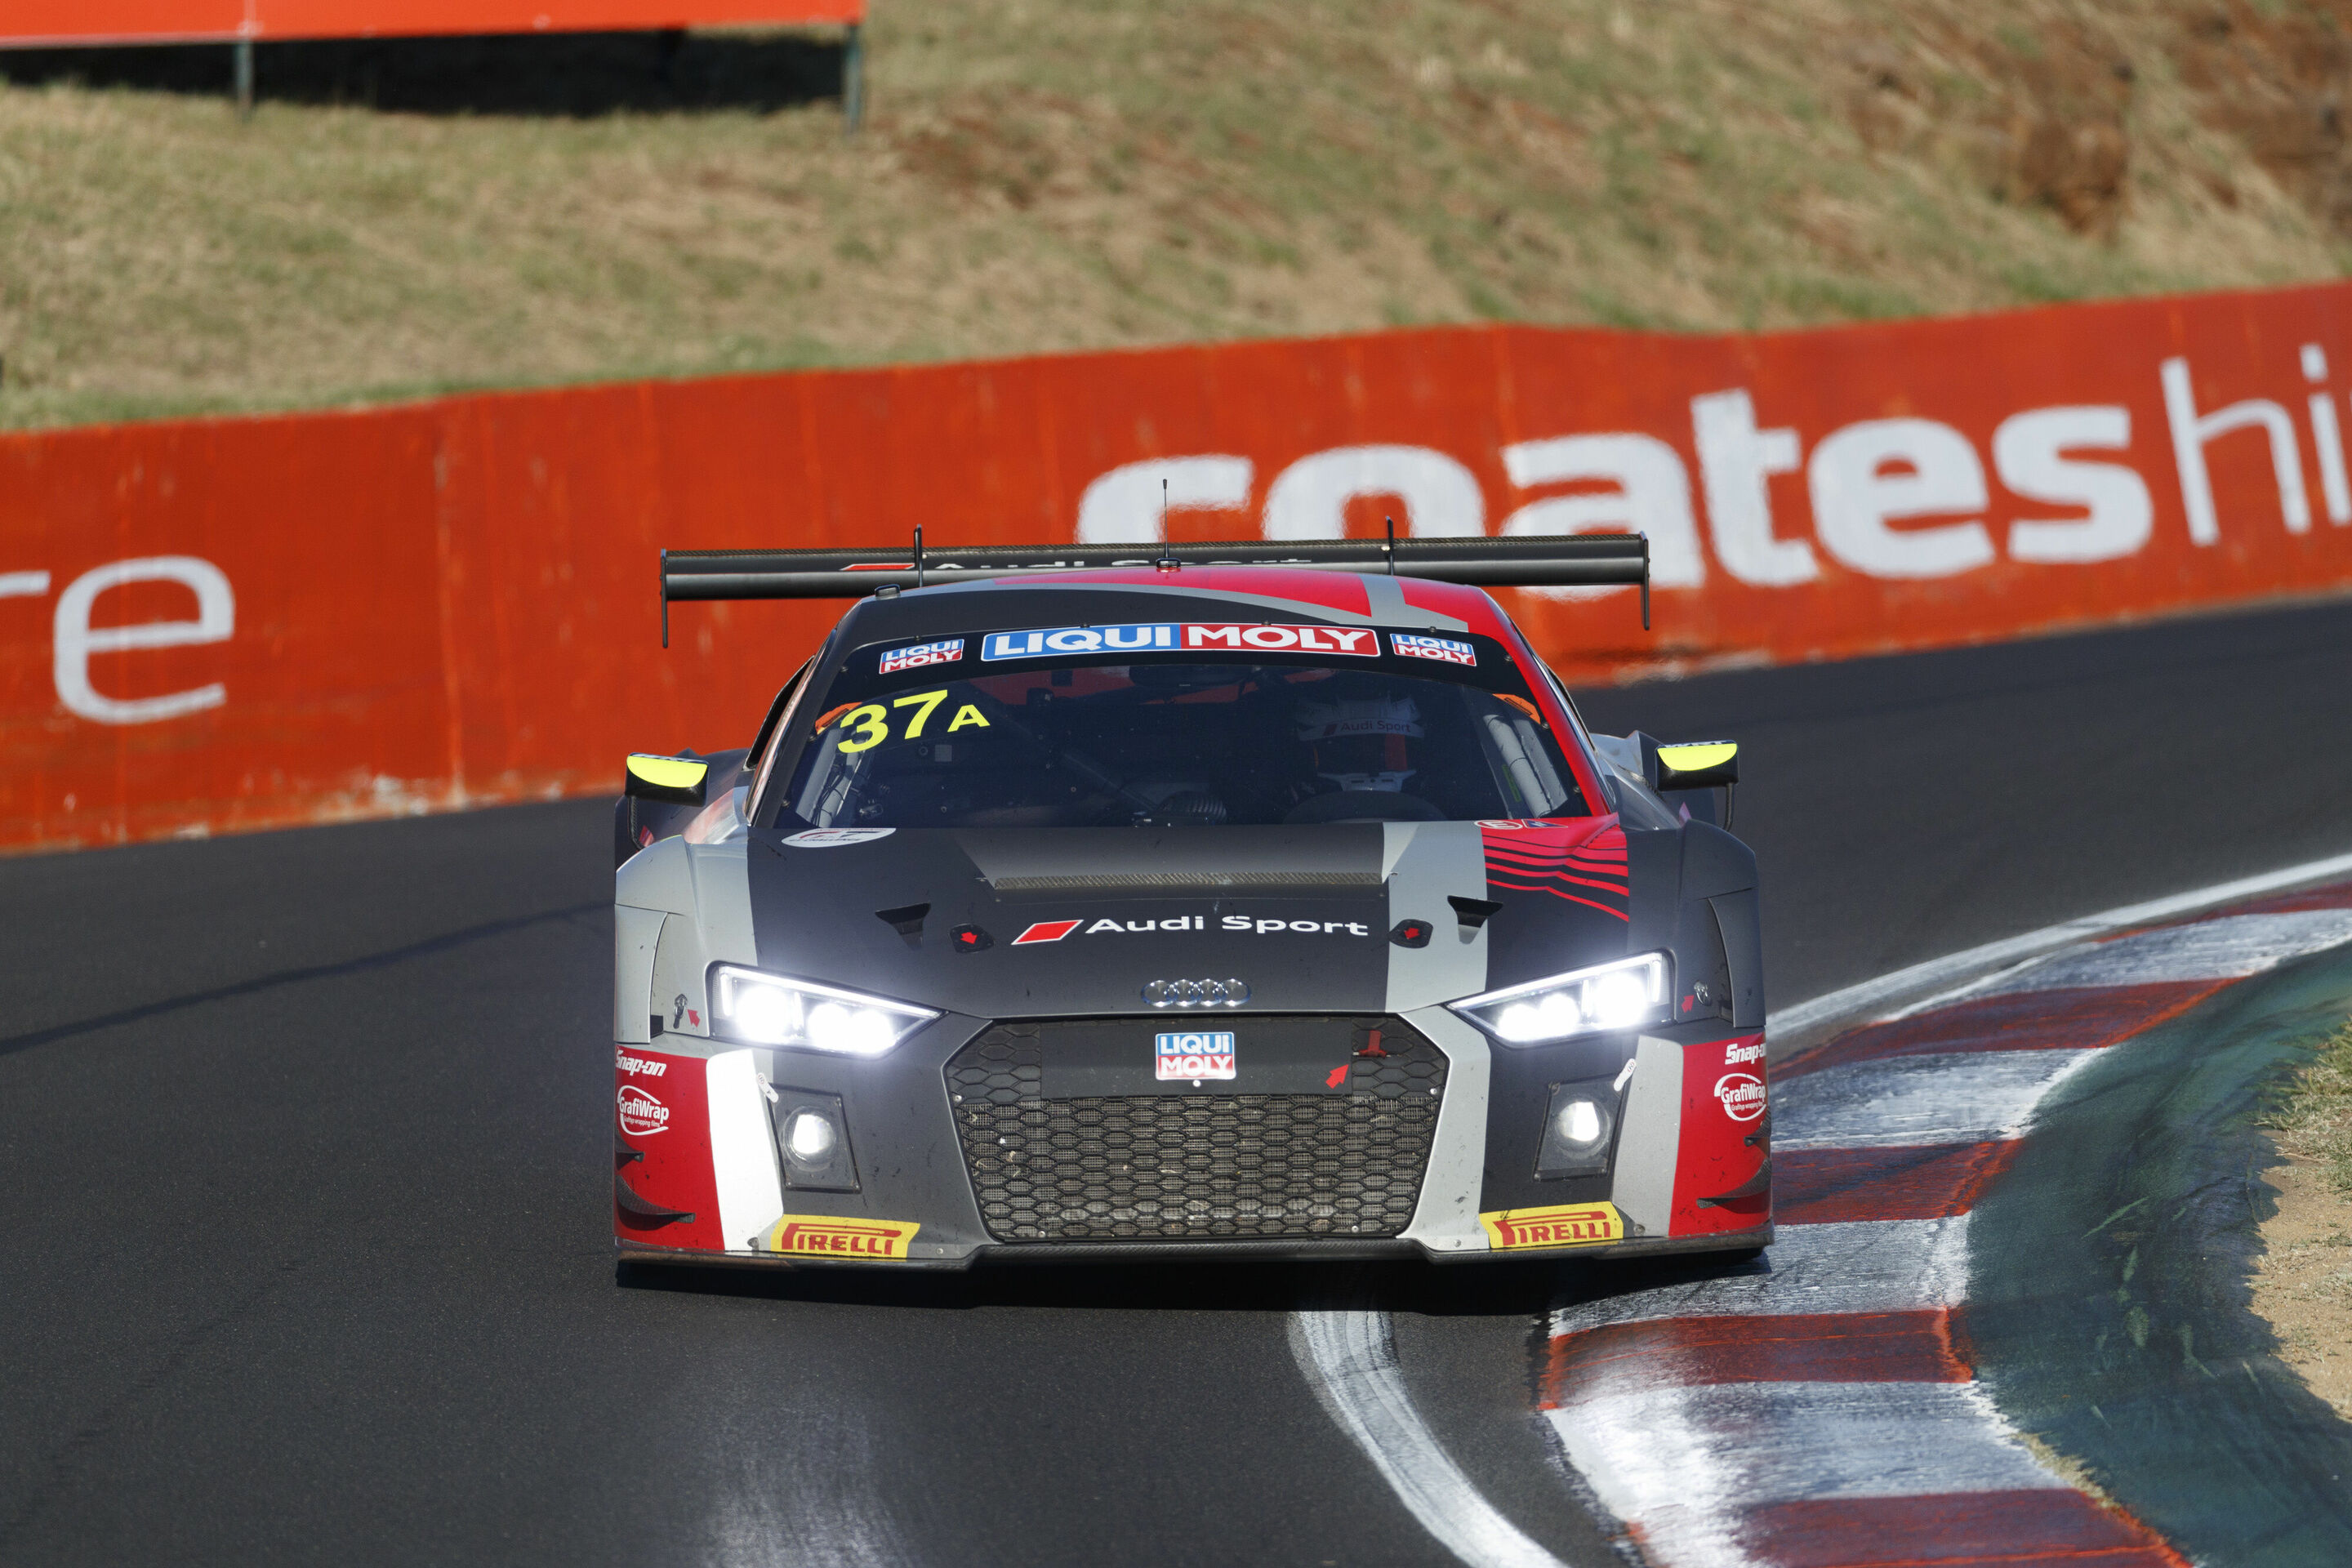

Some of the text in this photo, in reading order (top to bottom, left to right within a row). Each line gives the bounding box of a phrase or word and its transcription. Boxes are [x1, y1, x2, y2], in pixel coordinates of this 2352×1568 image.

[885, 640, 960, 661] LIQUI
[995, 626, 1369, 656] LIQUI MOLY
[1396, 635, 1469, 653] LIQUI
[884, 649, 960, 672] MOLY
[1397, 644, 1472, 663] MOLY
[1340, 719, 1411, 733] Audi Sport
[1085, 915, 1369, 936] Audi Sport
[1160, 1035, 1230, 1054] LIQUI
[1725, 1043, 1766, 1065] Snap-o
[616, 1049, 667, 1076] Snap-on
[1160, 1055, 1232, 1076] MOLY
[1721, 1083, 1766, 1104] GrafiWrap
[619, 1096, 670, 1125] GrafiWrap
[782, 1223, 902, 1255] PIRELLI
[1484, 1211, 1611, 1246] PIRELLI
